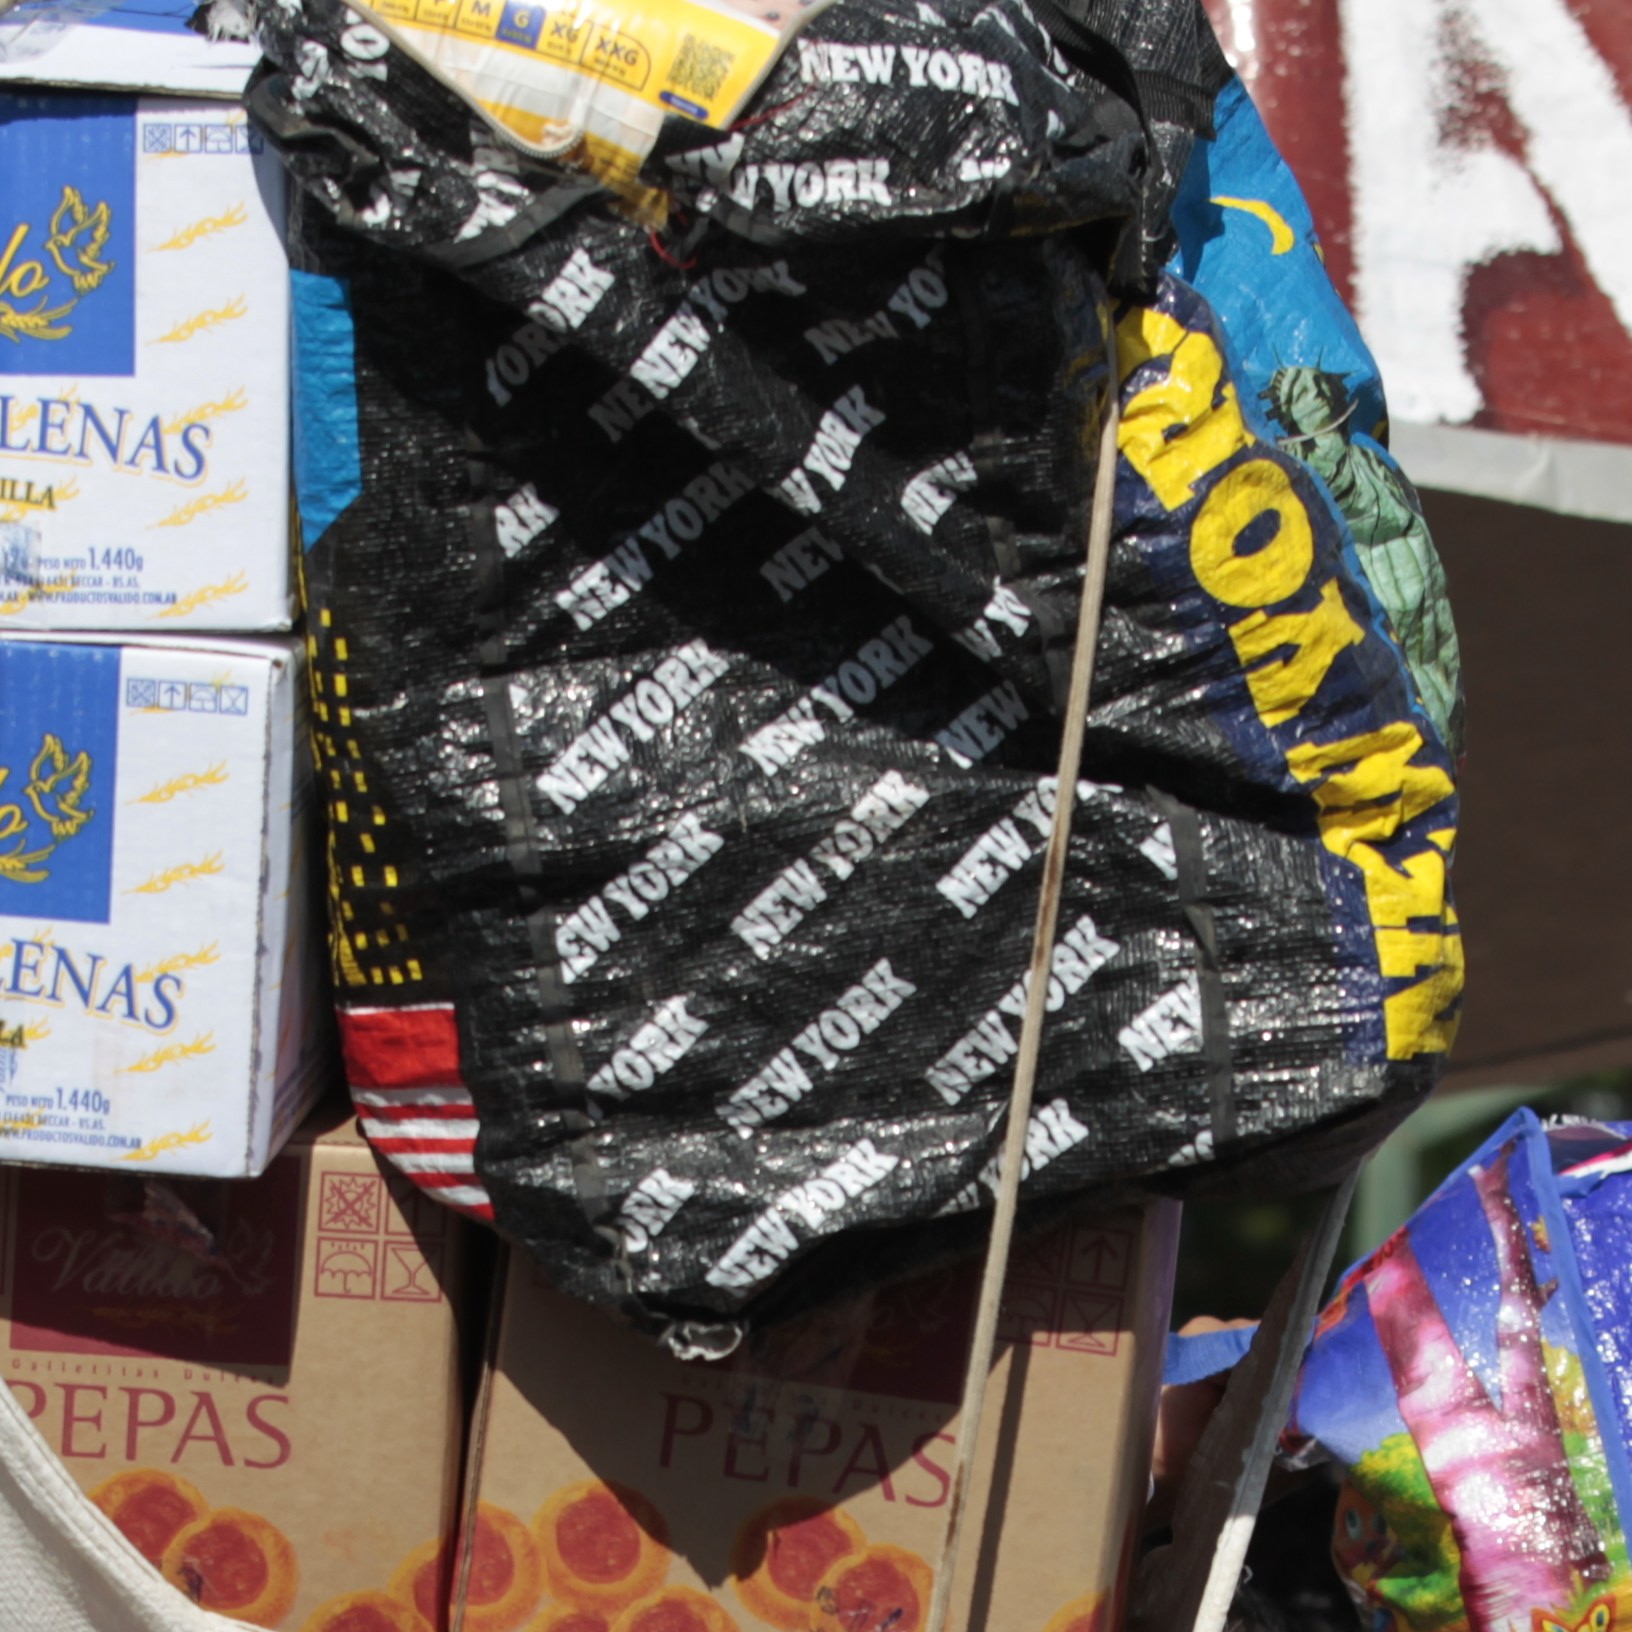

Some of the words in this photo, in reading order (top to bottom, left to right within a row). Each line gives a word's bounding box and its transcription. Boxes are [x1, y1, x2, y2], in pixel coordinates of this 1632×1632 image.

[596, 35, 639, 66] XXG
[797, 37, 895, 84] NEW
[901, 45, 1020, 106] YORK
[762, 158, 892, 211] YORK
[802, 384, 887, 492] YORK
[87, 546, 144, 572] 1.440g
[555, 535, 654, 632] NEW
[639, 460, 758, 561] YORK
[536, 715, 630, 815] NEW
[609, 636, 731, 743] YORK
[737, 697, 826, 777] NEW
[810, 613, 935, 724] YORK
[933, 680, 1032, 770] NEW
[554, 895, 622, 985] EW
[602, 811, 726, 922] YORK
[729, 857, 829, 961] NEW
[809, 768, 931, 882] YORK
[935, 817, 1033, 920] NEW
[586, 993, 710, 1099] YORK
[715, 1047, 814, 1140] NEW
[791, 956, 918, 1072] YORK
[925, 1008, 1020, 1107] NEW
[55, 1086, 111, 1116] 1.440g
[778, 1136, 901, 1231] YORK
[12, 1357, 160, 1379] Galletitas
[658, 1390, 957, 1509] PEPAS
